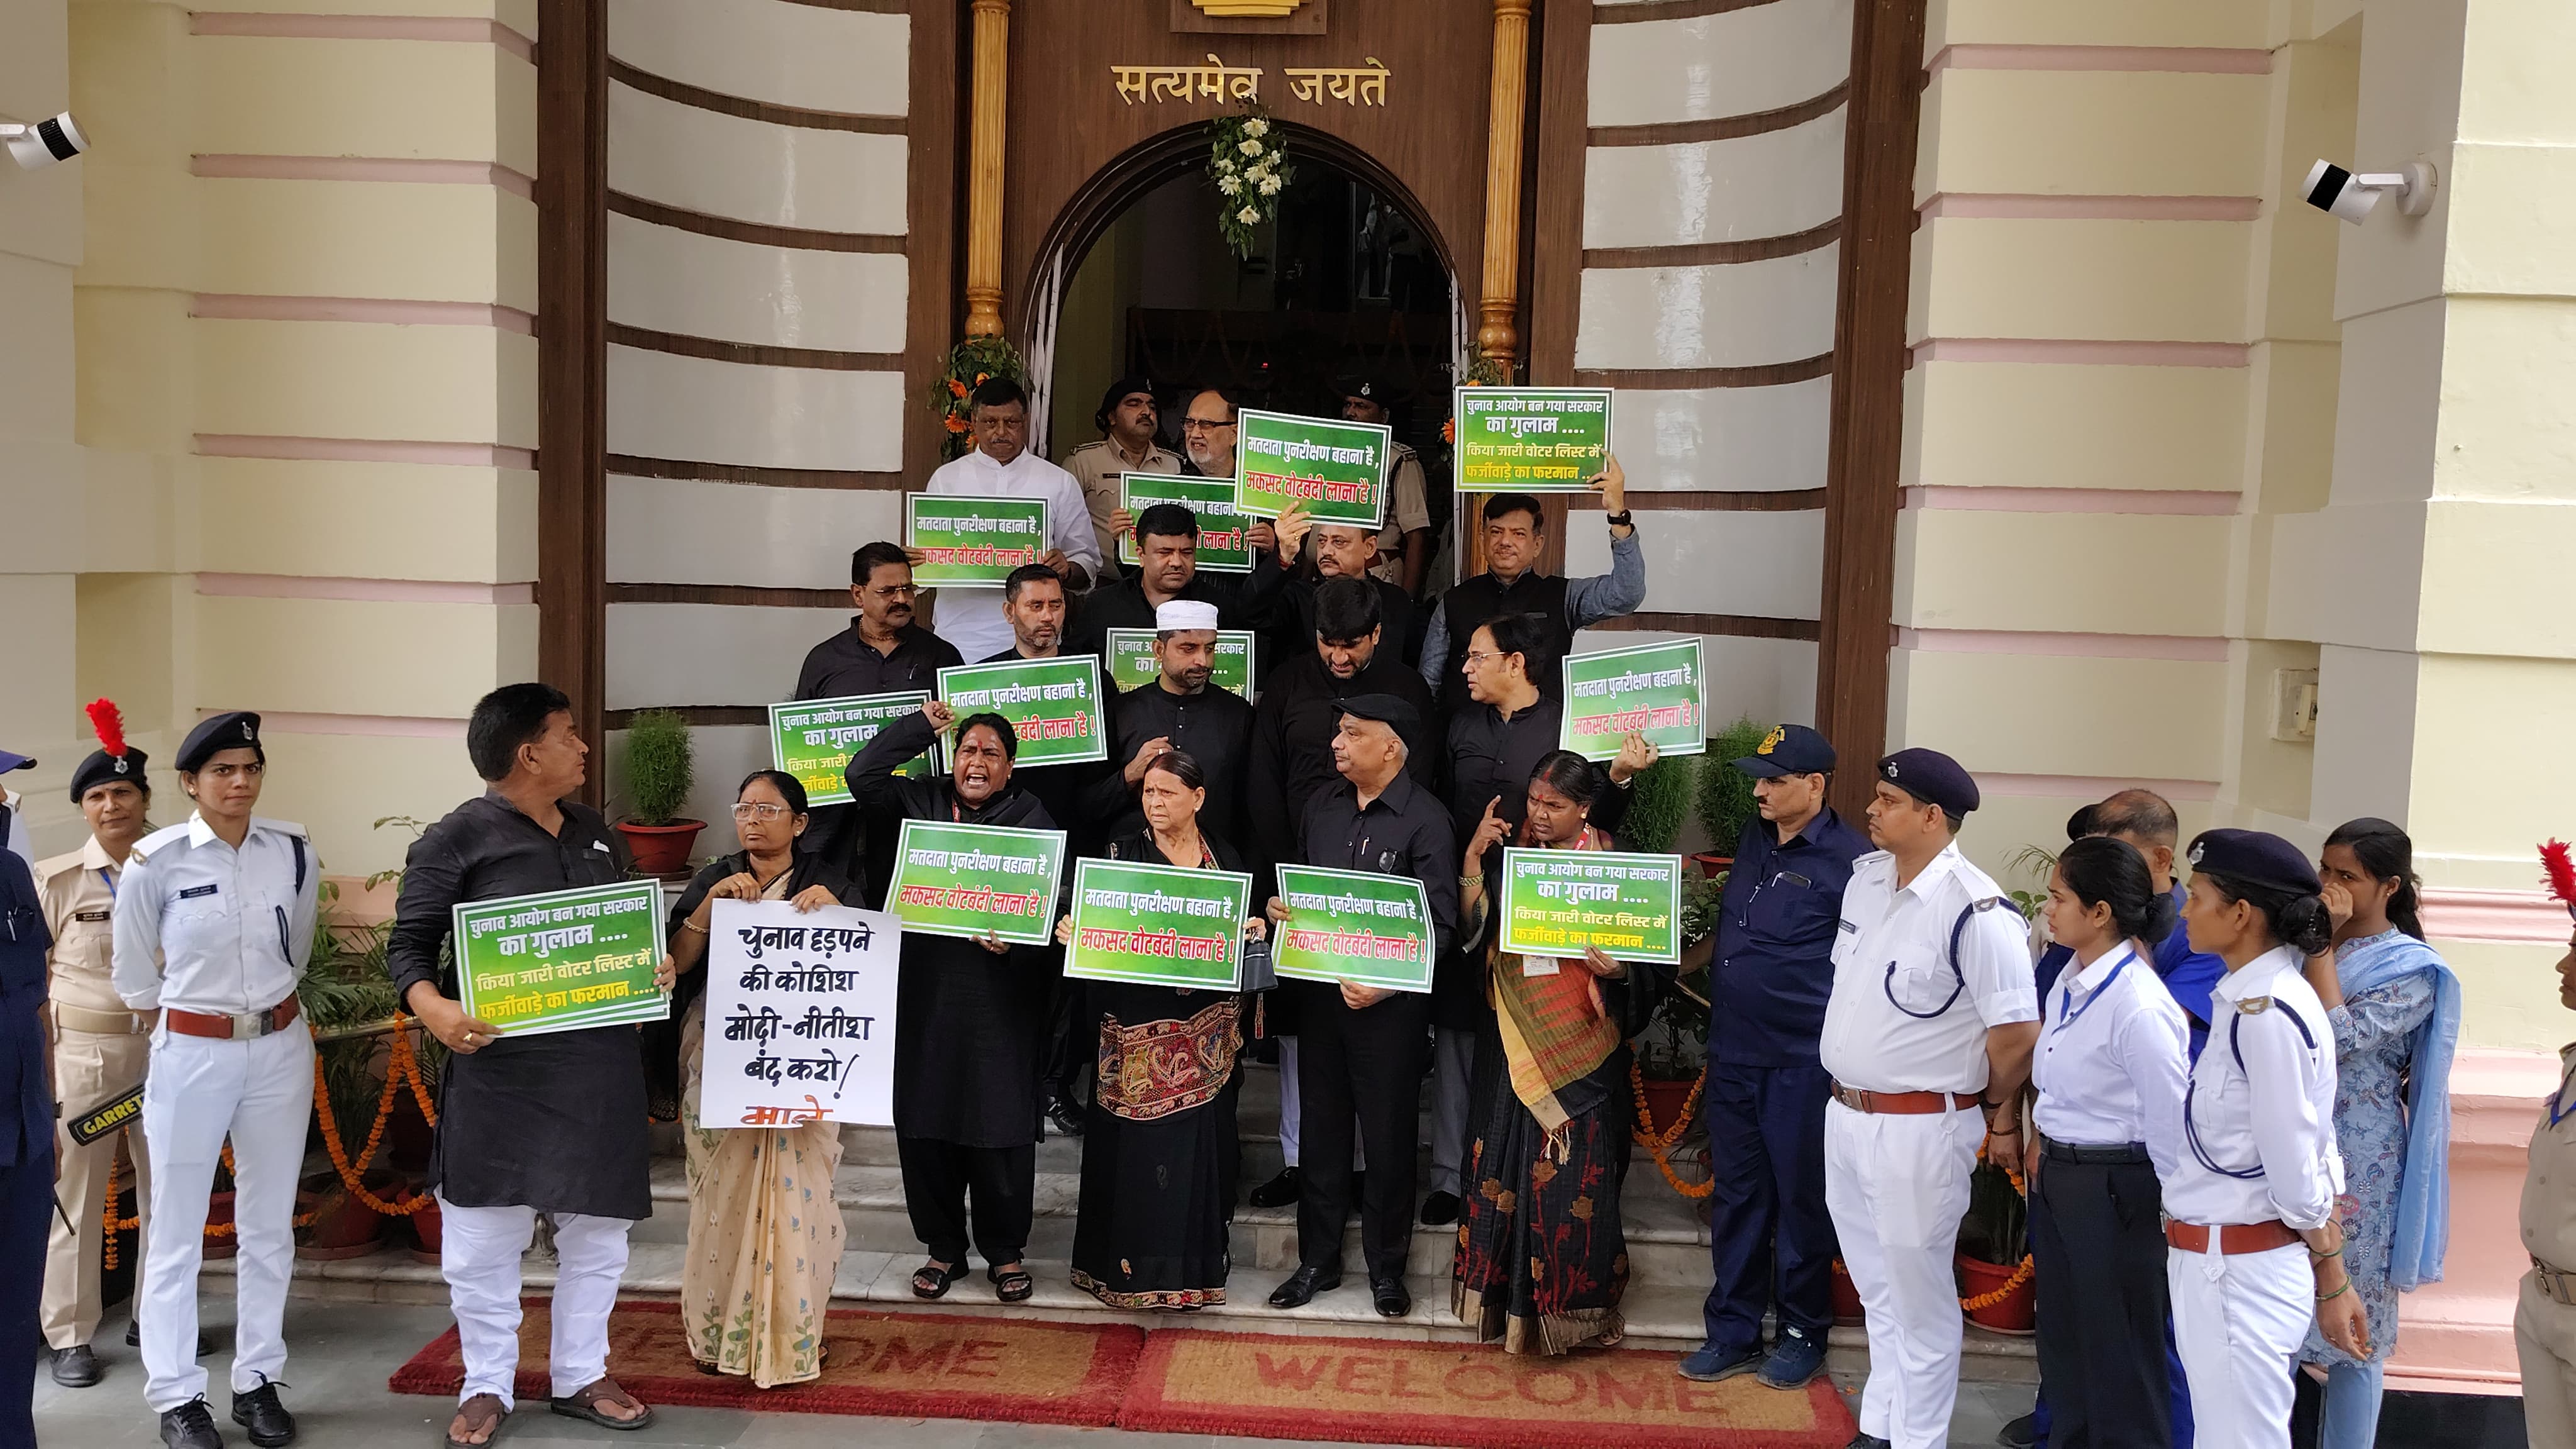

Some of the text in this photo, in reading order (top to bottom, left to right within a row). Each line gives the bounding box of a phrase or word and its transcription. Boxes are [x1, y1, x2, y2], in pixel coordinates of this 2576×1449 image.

[1111, 53, 1391, 107] सत्यमेव जयते
[1466, 397, 1603, 414] चुनाव आयोग बन गया सरकार
[1485, 416, 1507, 433] का
[1509, 416, 1559, 438] गुलाम
[1247, 436, 1282, 456] मतदाता
[1283, 439, 1330, 462] पुनरीक्षण
[1331, 447, 1364, 465] बहाना
[1466, 442, 1602, 458] किया जारी वोटर लिस्ट में
[1514, 466, 1531, 479] का
[1532, 466, 1579, 479] फरमान
[1245, 471, 1283, 494] मकसद
[1285, 471, 1324, 499] वोटबंदी
[1326, 481, 1358, 502] लाना
[916, 517, 952, 531] मतदाता
[953, 514, 997, 535] पुनरीक्षण
[998, 518, 1027, 533] बहाना
[1203, 531, 1231, 549] लाना
[957, 543, 994, 565] वोटबंदी
[996, 548, 1026, 566] लाना
[1117, 641, 1143, 655] चुनाव
[1135, 657, 1156, 672] का
[950, 690, 990, 708] मतदाता
[991, 683, 1041, 710] पुनरीक्षण
[1042, 683, 1075, 700] बहाना
[1574, 679, 1607, 697] मतदाता
[1608, 670, 1652, 699] पुनरीक्षण
[1653, 669, 1682, 687] बहाना
[781, 714, 809, 731] चुनाव
[813, 708, 843, 724] आयोग
[845, 710, 862, 721] बन
[864, 708, 884, 719] गया
[1042, 717, 1076, 740] लाना
[1572, 714, 1611, 736] मकसद
[1611, 703, 1650, 733] वोटबंदी
[1650, 706, 1681, 729] लाना
[802, 724, 879, 749] का गुलाम
[787, 757, 816, 772] किया
[819, 753, 847, 769] जारी
[908, 849, 950, 868] मतदाता
[950, 849, 1001, 874] पुनरीक्षण
[1002, 856, 1037, 875] बहाना
[1516, 861, 1669, 880] चुनाव आयोग बन गया सरकार
[899, 884, 946, 907] मकसद
[946, 883, 992, 912] वोटबंदी
[991, 893, 1027, 916] लाना
[1085, 889, 1128, 909] मतदाता
[1129, 889, 1185, 916] पुनरीक्षण
[1186, 898, 1222, 918] बहाना
[1289, 892, 1327, 911] मतदाता
[1327, 892, 1374, 918] पुनरीक्षण
[1375, 900, 1407, 919] बहाना
[1536, 880, 1561, 898] का
[1564, 880, 1619, 904] गुलाम
[470, 896, 648, 939] चुनाव आयोग बन गया सरकार
[1514, 906, 1668, 929] किया जारी वोटर लिस्ट में
[497, 934, 528, 956] का
[531, 924, 594, 958] गुलाम
[738, 921, 875, 958] चुनाव हड़पने
[1080, 926, 1129, 952] मकसद
[1130, 925, 1177, 958] वोटबंदी
[1179, 935, 1214, 962] लाना
[1286, 929, 1331, 953] मकसद
[1331, 926, 1373, 958] वोटबंदी
[1374, 936, 1406, 960] लाना
[1568, 931, 1589, 945] का
[1590, 933, 1643, 948] फरमान
[475, 948, 652, 992] किया जारी वोटर लिस्ट में
[740, 961, 860, 993] की कोशिश
[545, 990, 567, 1009] का
[569, 980, 629, 1004] फरमान
[745, 1049, 782, 1087] बंद
[83, 1092, 145, 1135] GARRET
[1255, 1351, 1731, 1417] WELCOME
